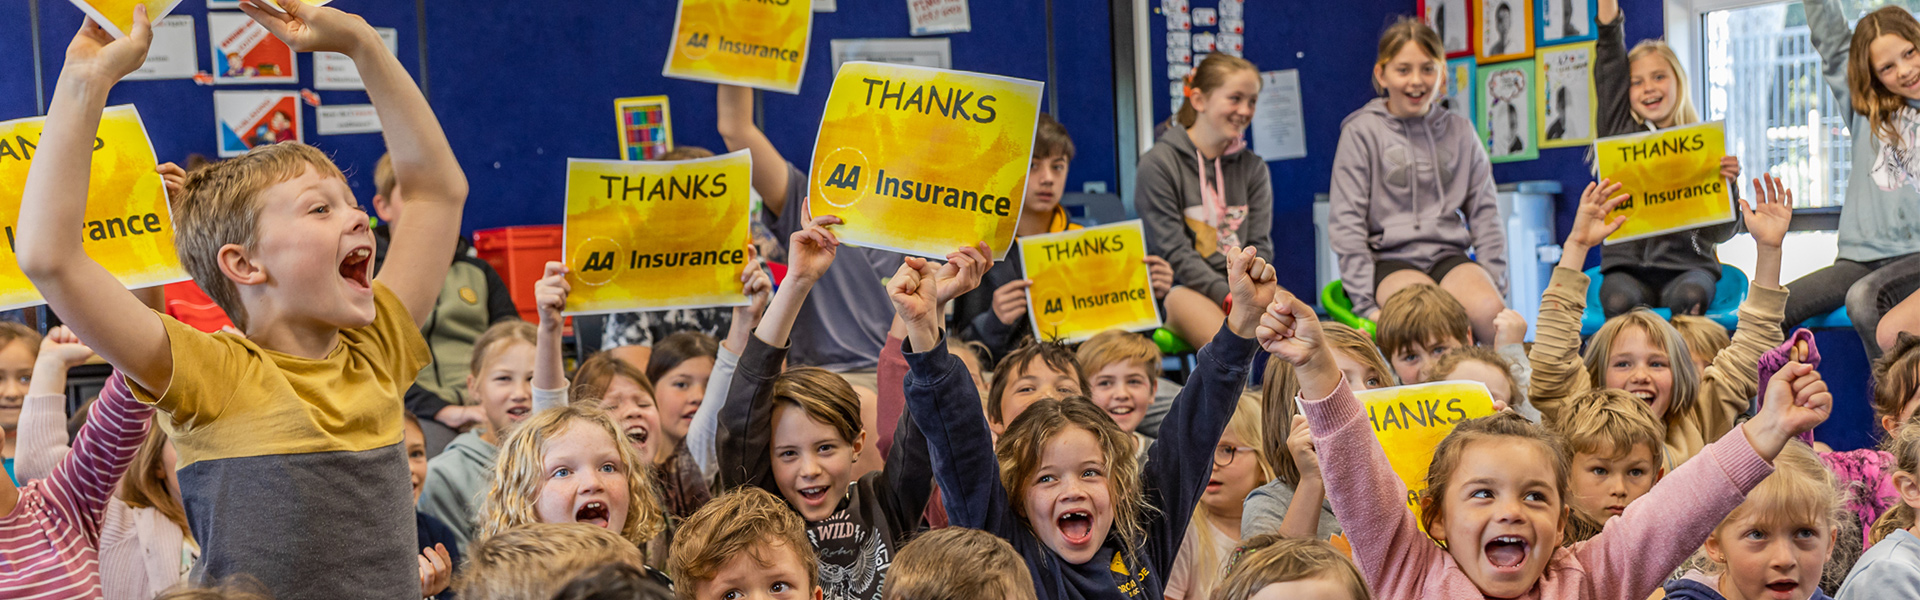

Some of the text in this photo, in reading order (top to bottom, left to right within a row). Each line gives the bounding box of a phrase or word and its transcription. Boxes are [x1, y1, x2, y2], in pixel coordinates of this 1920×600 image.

[686, 32, 799, 63] AA Insurance
[862, 77, 997, 124] THANKS
[1617, 134, 1704, 162] THANKS
[600, 173, 727, 202] THANKS
[825, 163, 1011, 217] AA Insurance
[1644, 181, 1721, 206] Insurance
[581, 249, 743, 272] AA Insurance
[1041, 234, 1124, 262] THANKS
[1044, 288, 1146, 315] AA Insurance
[1369, 398, 1466, 432] HANKS
[817, 522, 854, 541] WILD
